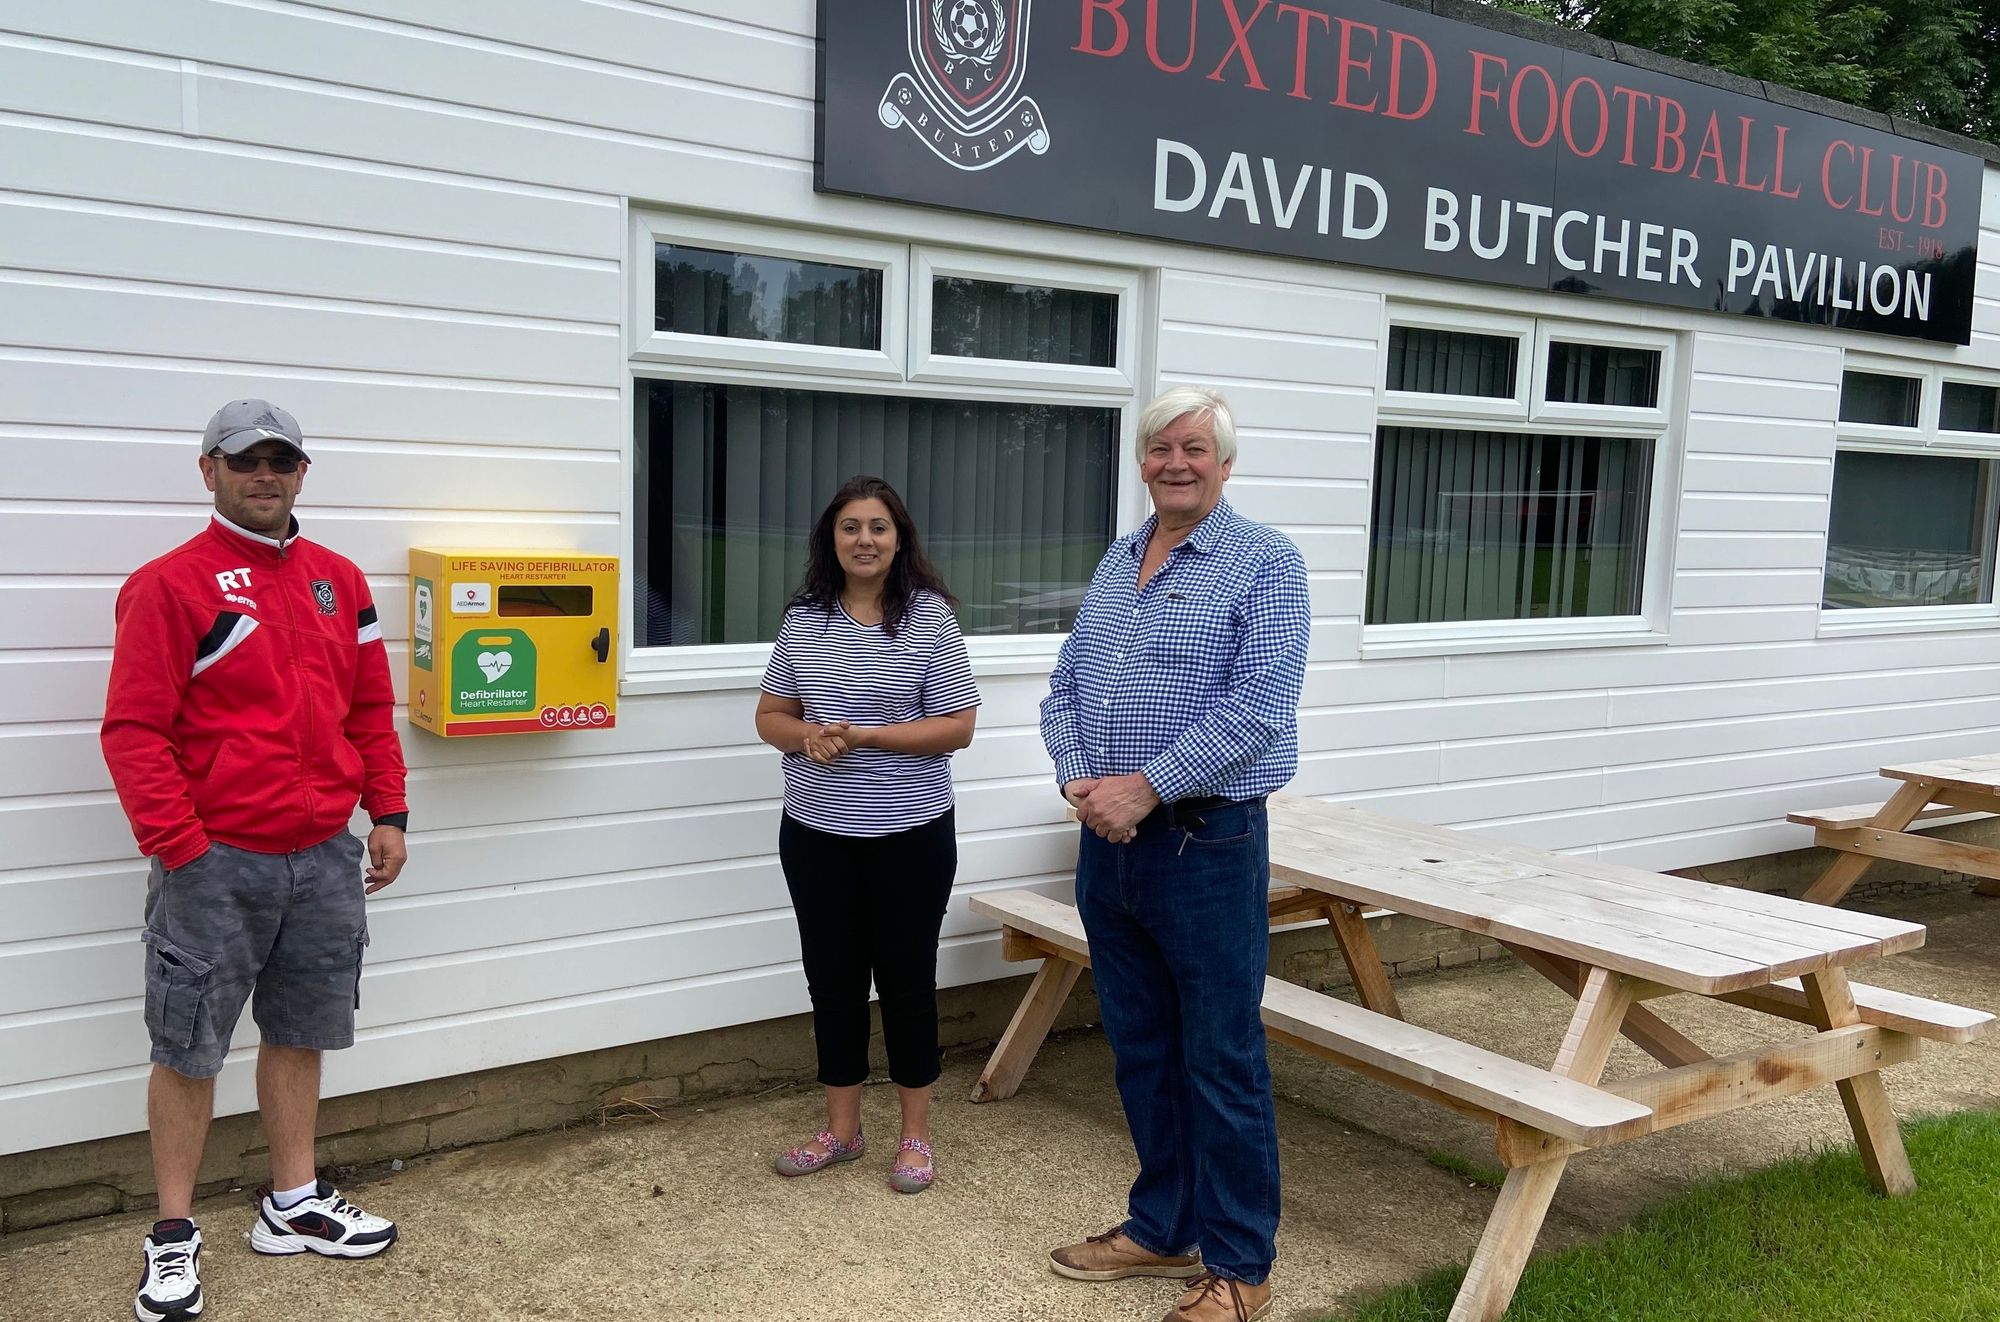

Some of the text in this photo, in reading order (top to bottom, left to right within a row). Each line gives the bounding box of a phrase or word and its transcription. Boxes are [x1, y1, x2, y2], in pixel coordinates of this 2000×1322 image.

[1071, 0, 1948, 229] BUXTED FOOTBALL CLUB
[917, 112, 1014, 159] BUXTED
[1154, 138, 1931, 321] DAVID BUTCHER PAVILION
[1879, 227, 1904, 251] EST
[452, 562, 615, 572] LIFE SAVING DEFIBRILLATOR
[215, 567, 252, 592] RT
[460, 689, 528, 700] Defibrillator
[460, 699, 528, 708] Heart Restarter
